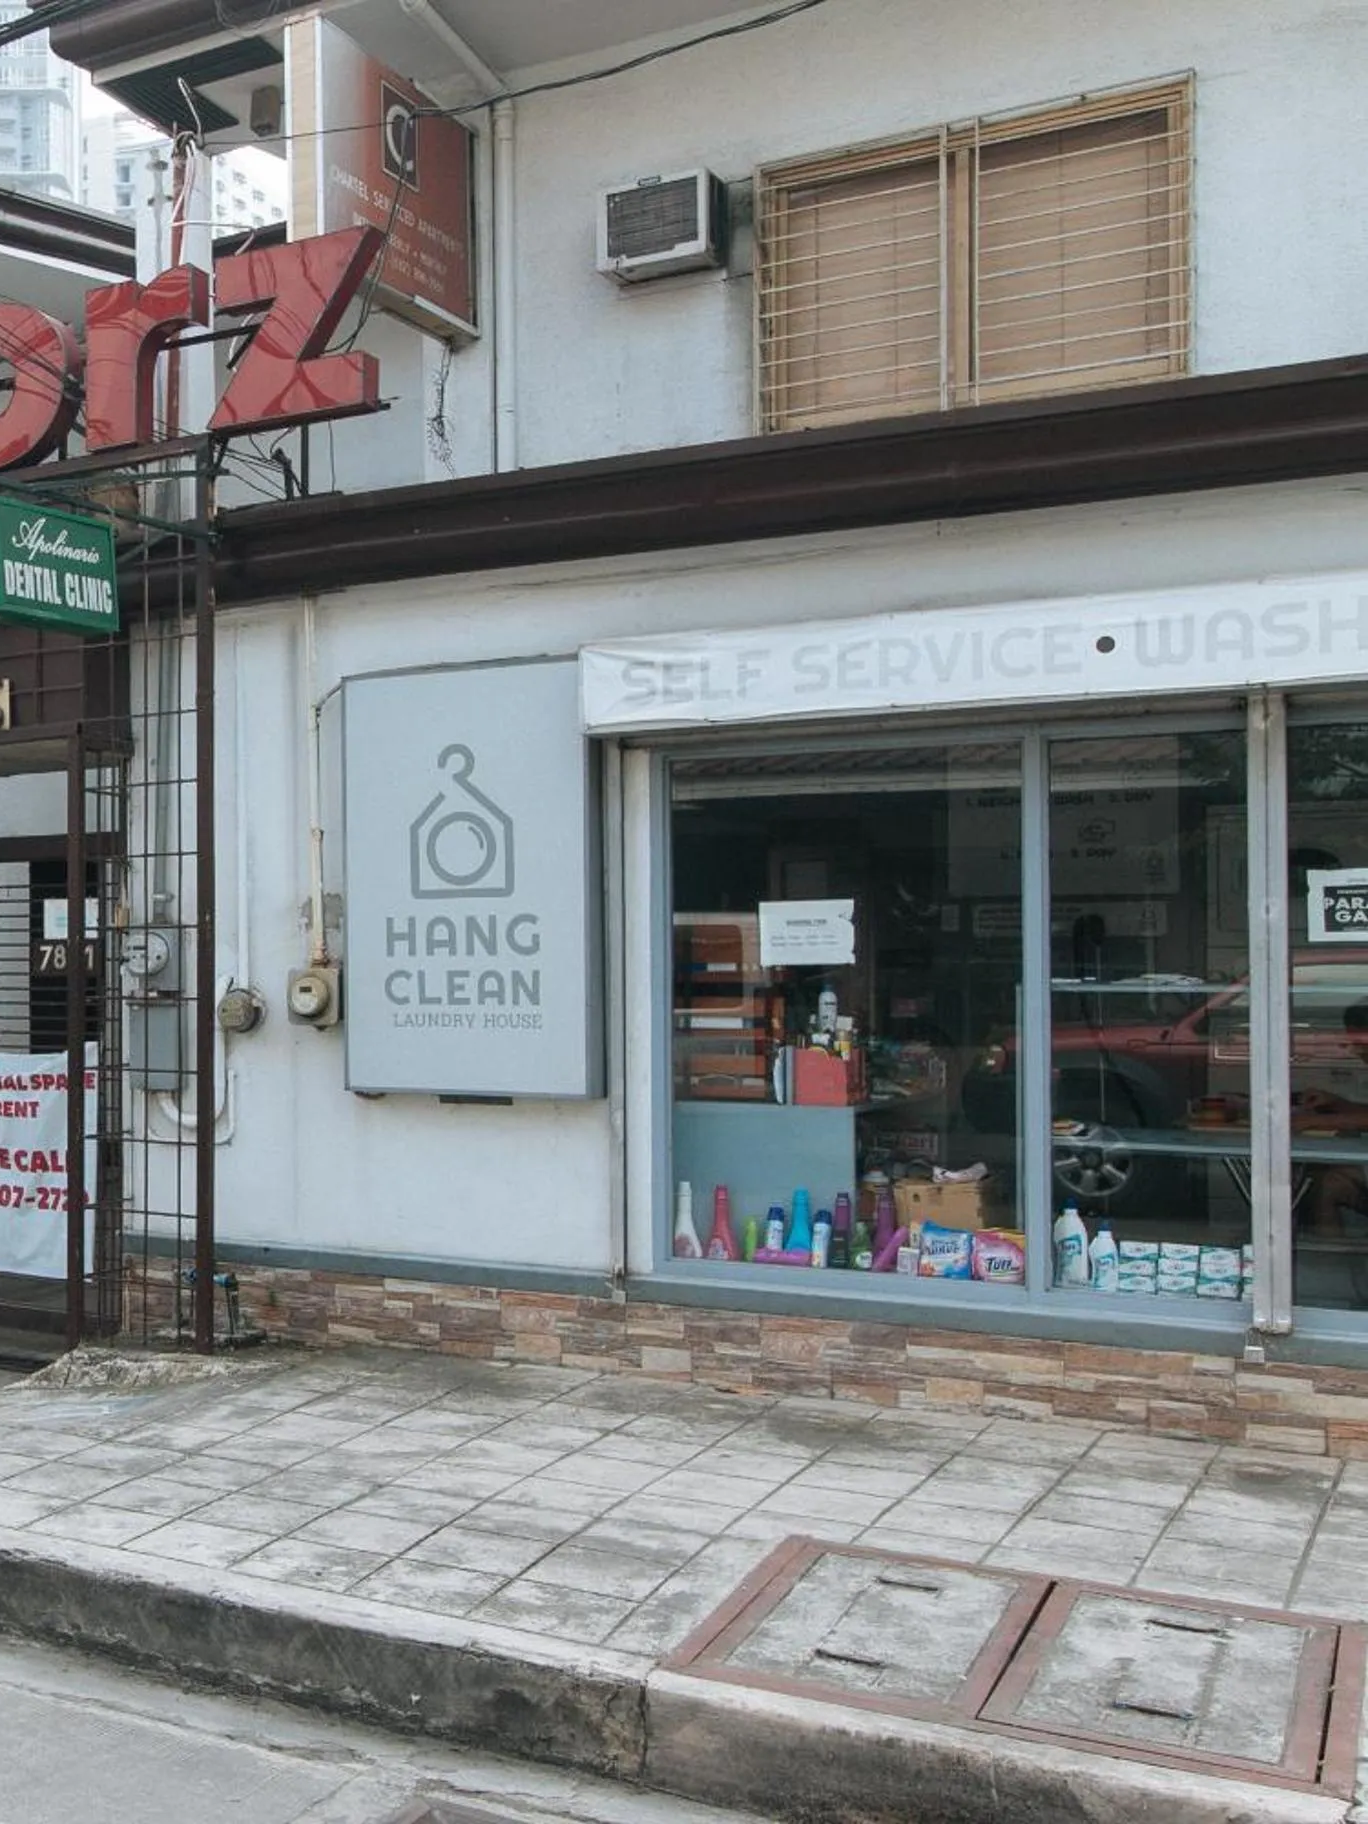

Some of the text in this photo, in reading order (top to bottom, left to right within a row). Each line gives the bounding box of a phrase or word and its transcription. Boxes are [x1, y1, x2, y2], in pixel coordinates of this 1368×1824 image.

[12, 517, 100, 564] Apolinario
[3, 559, 113, 614] DENTAL CLINIC
[620, 594, 1368, 704] SELF SERVICE WASH
[1324, 896, 1368, 910] PAR
[385, 913, 541, 958] HANG
[39, 944, 96, 972] 781
[384, 968, 541, 1007] CLEAN
[392, 1012, 543, 1030] LAUNDRY HOUSE
[30, 1072, 96, 1091] SPAE
[14, 1149, 69, 1173] CAL
